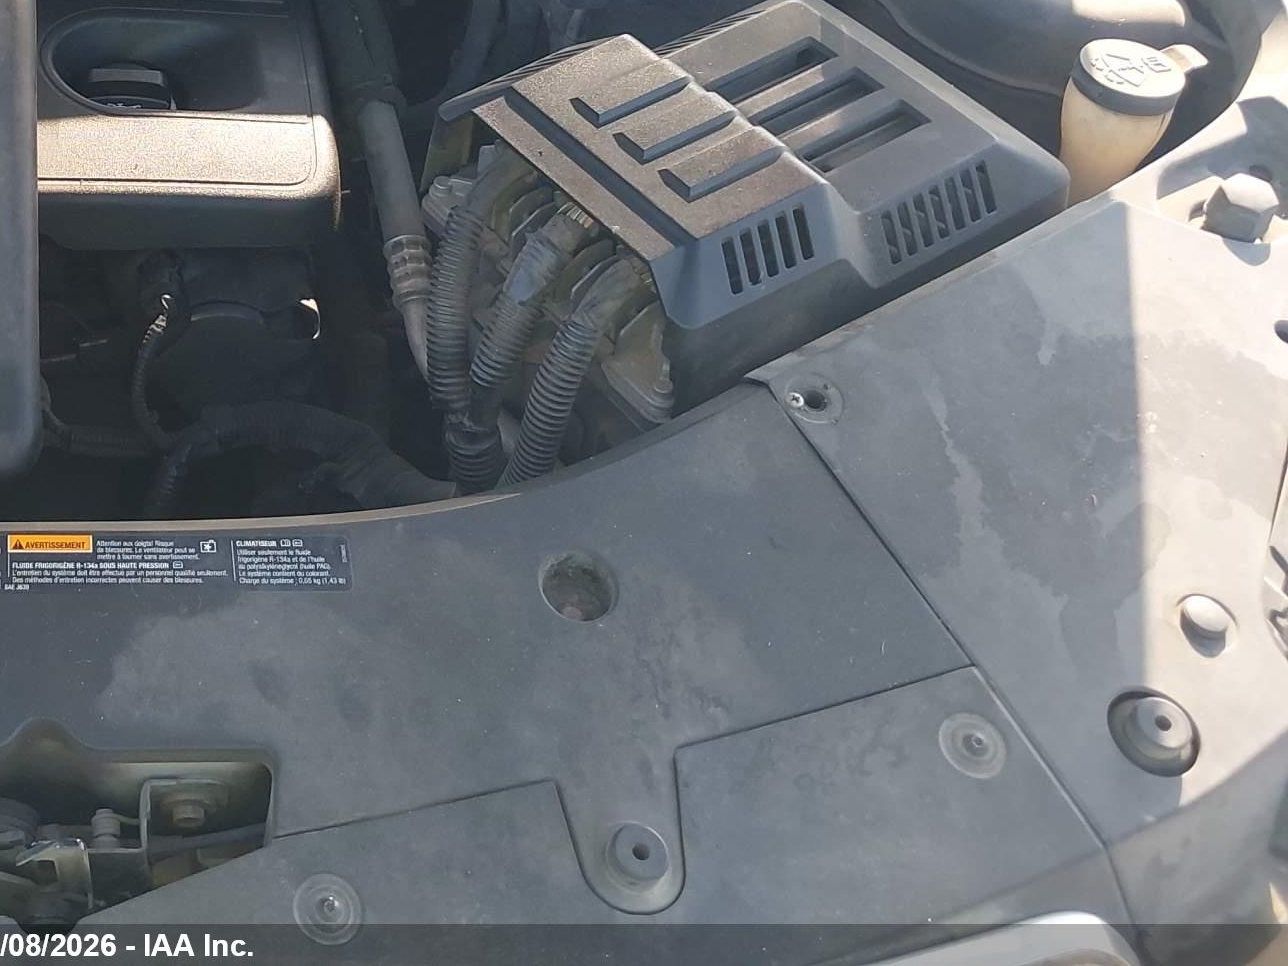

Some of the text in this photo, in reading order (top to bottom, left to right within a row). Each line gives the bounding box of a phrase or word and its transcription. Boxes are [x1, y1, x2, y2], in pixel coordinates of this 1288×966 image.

[239, 577, 260, 585] Charge
[269, 577, 294, 585] système
[313, 577, 321, 585] kg
